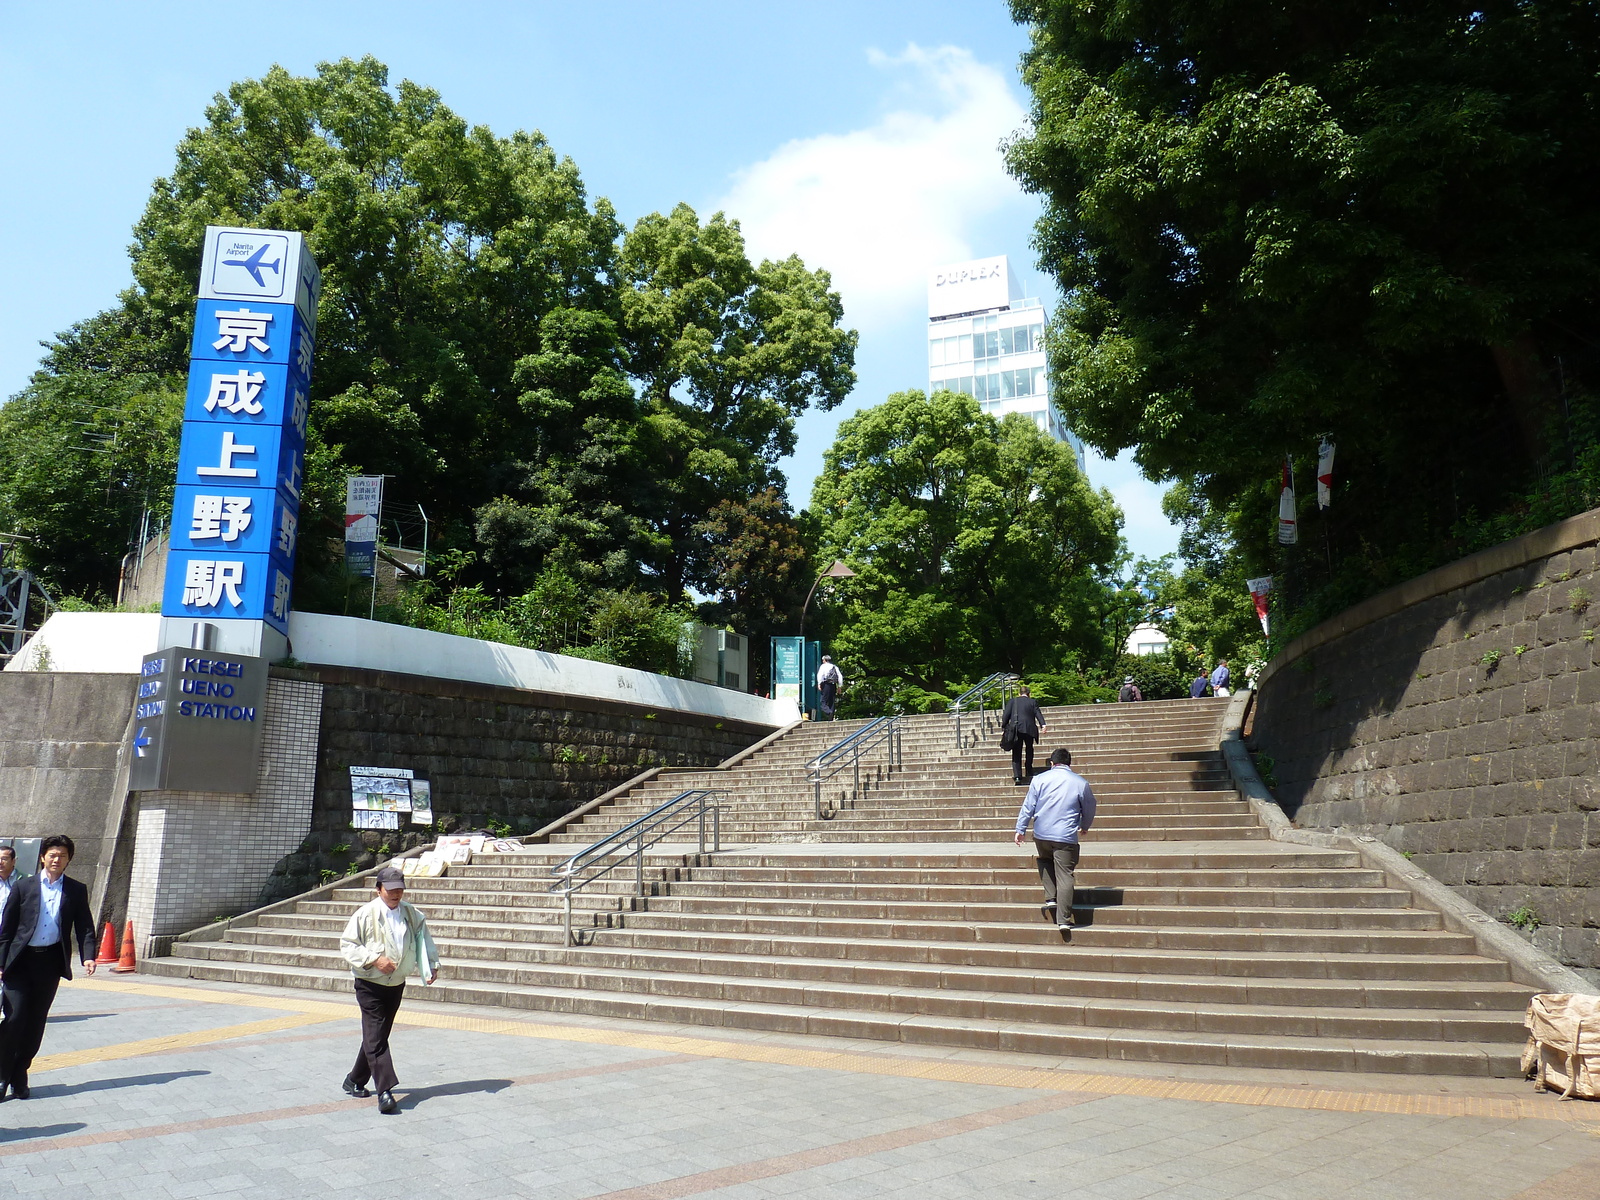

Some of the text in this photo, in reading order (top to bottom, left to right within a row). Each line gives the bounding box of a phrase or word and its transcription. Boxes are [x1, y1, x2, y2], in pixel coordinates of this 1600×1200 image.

[226, 248, 250, 256] Airport
[233, 243, 254, 251] Narita
[181, 308, 273, 608] 京成上野駅
[184, 658, 243, 678] KEISEI
[181, 679, 235, 698] UENO
[178, 700, 256, 722] STATION
